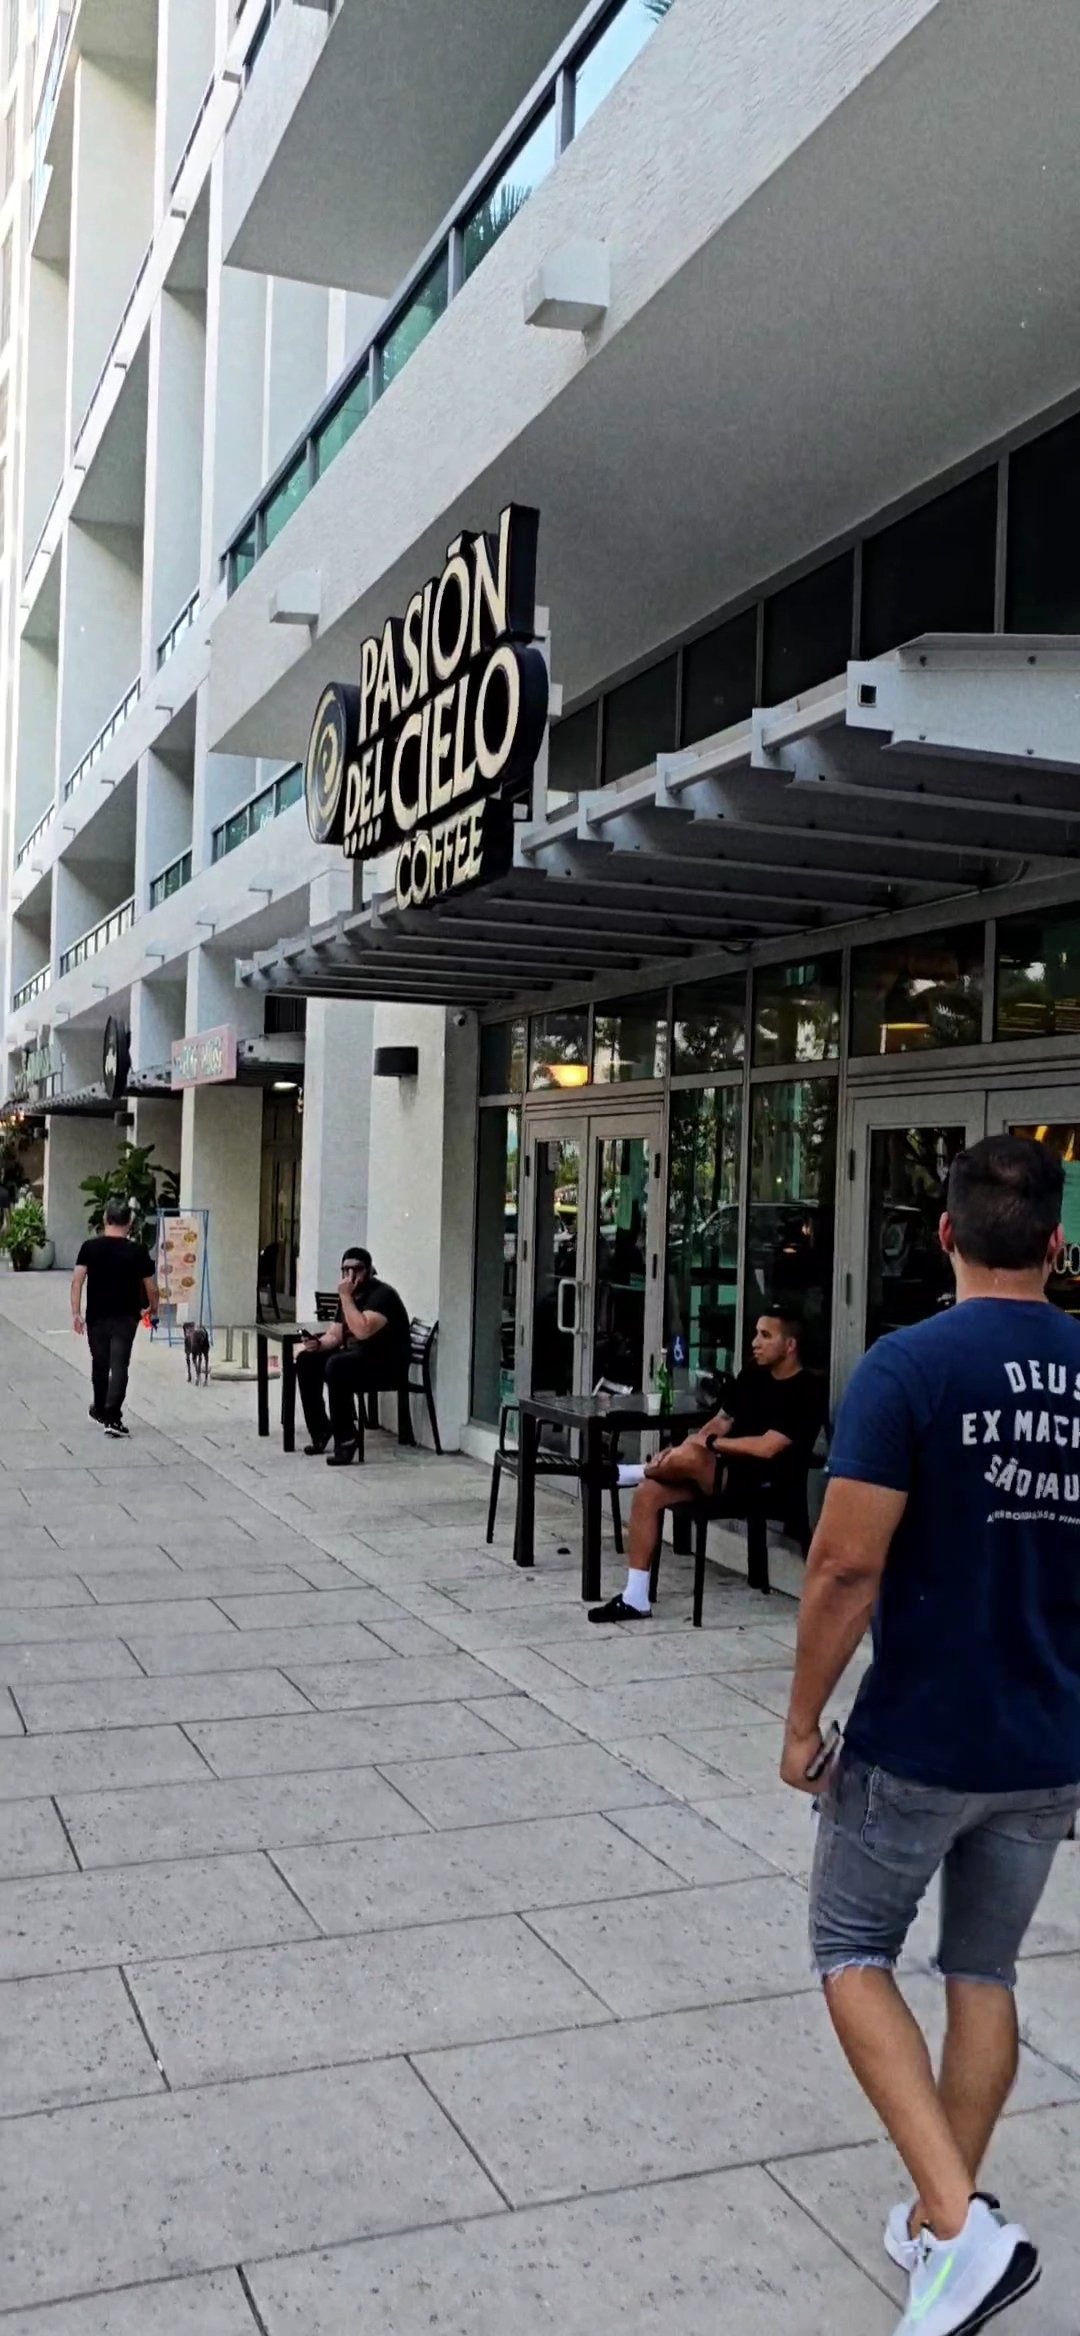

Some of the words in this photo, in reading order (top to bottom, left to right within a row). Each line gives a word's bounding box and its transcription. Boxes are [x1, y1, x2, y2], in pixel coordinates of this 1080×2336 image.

[358, 505, 513, 746] PASIÓN
[344, 738, 386, 837] DEL
[391, 645, 521, 832] CIELO
[396, 798, 486, 911] COFFEE
[962, 1409, 1001, 1446] EX
[984, 1454, 1032, 1498] SÃO
